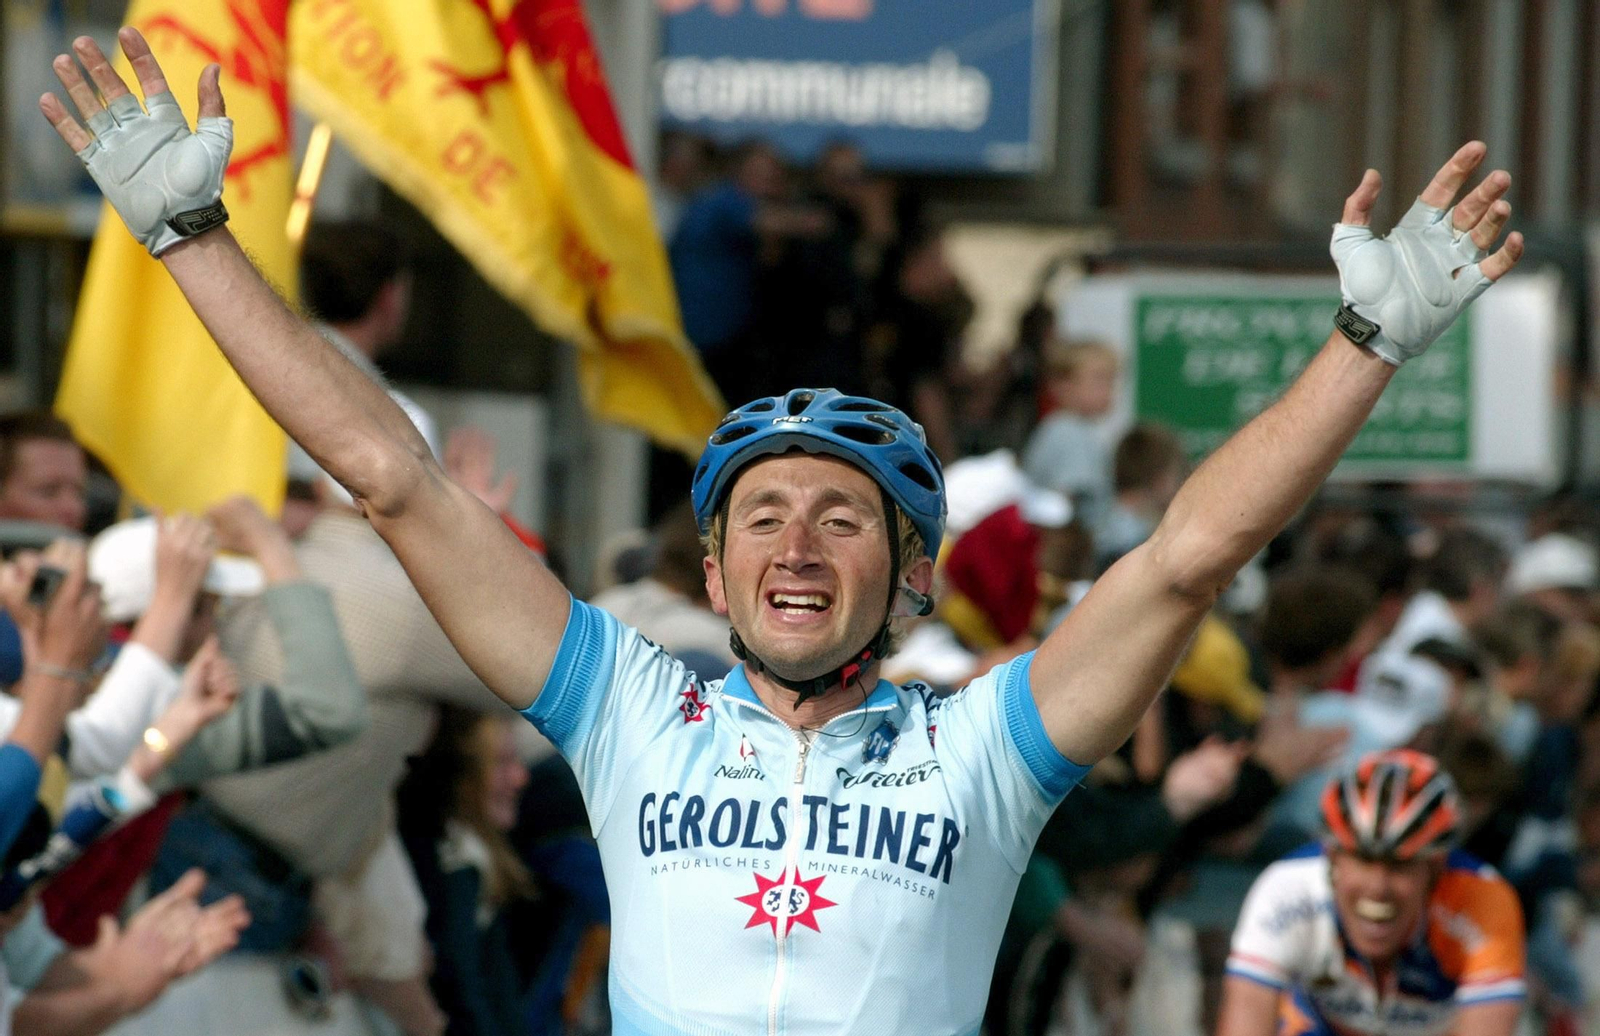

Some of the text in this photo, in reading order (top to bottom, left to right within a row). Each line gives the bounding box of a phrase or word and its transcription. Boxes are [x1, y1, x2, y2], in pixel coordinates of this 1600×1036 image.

[660, 47, 991, 132] communale
[836, 766, 942, 789] Wilier
[638, 791, 961, 885] GEROLSTEINER
[651, 856, 936, 900] NATÜRLICHES MINERALWASSER
